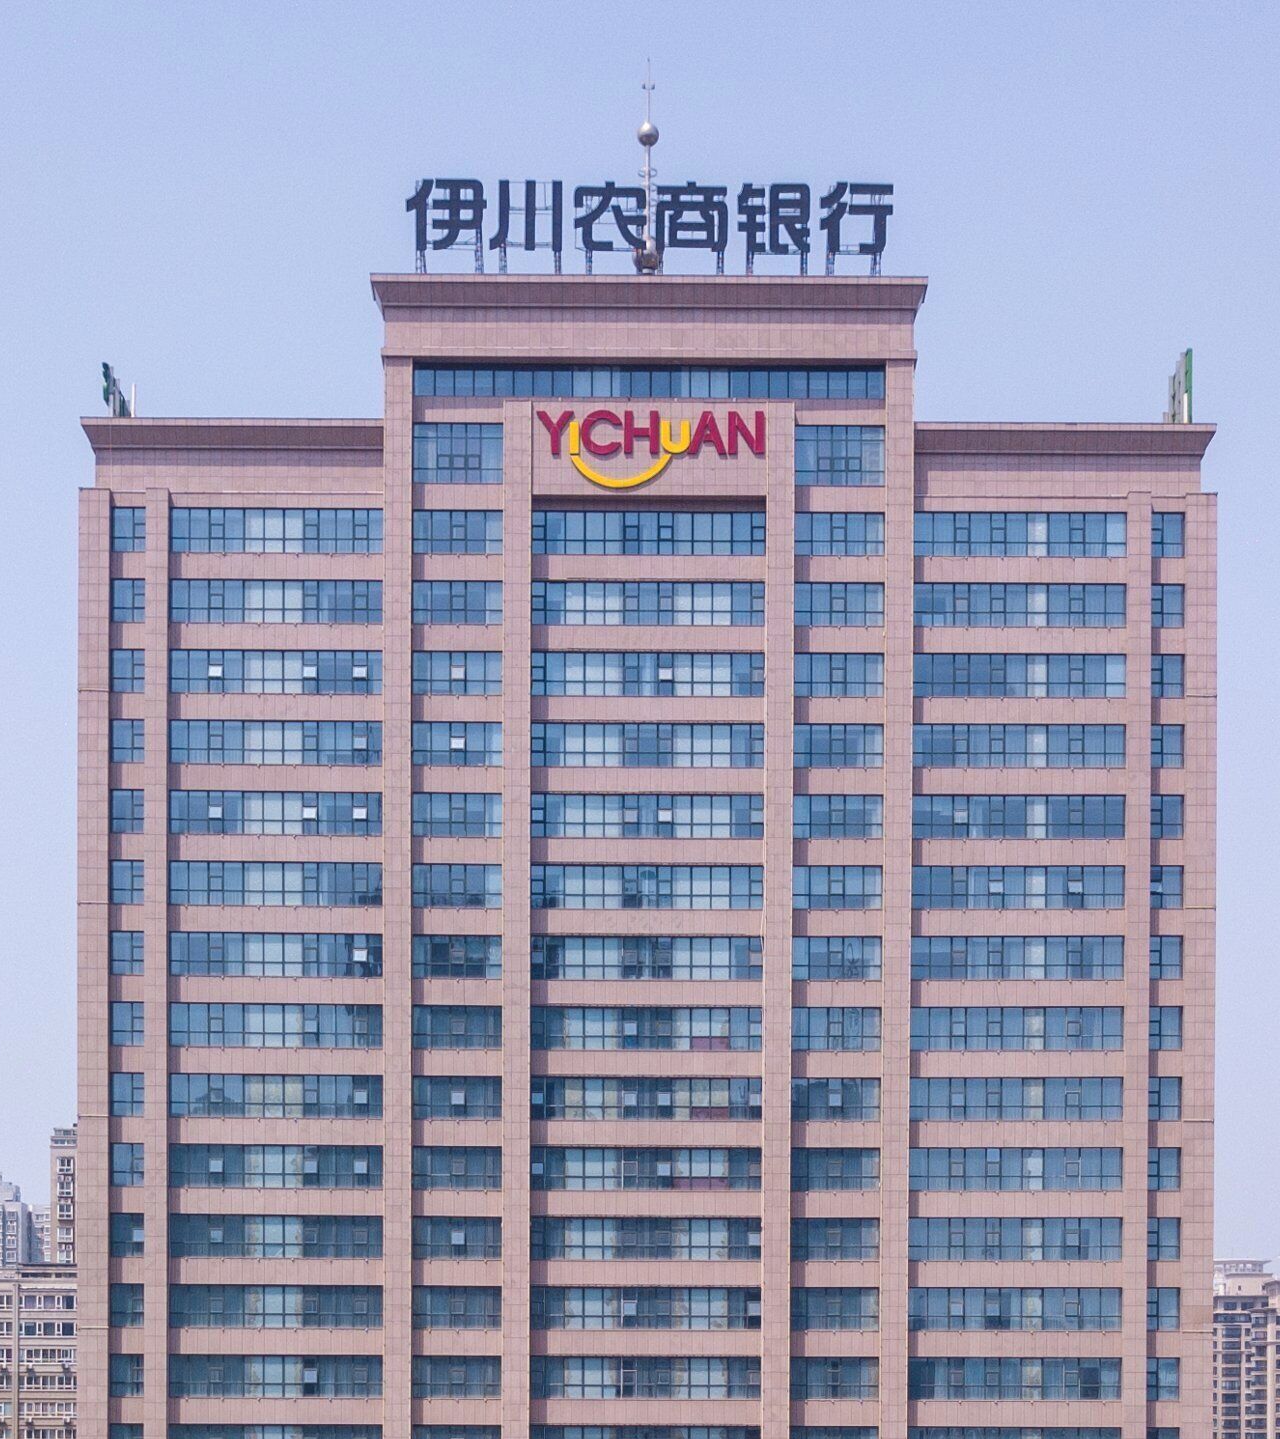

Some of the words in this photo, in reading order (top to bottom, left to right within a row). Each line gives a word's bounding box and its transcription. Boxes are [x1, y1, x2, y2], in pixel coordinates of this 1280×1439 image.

[406, 178, 894, 254] 伊川农商银行
